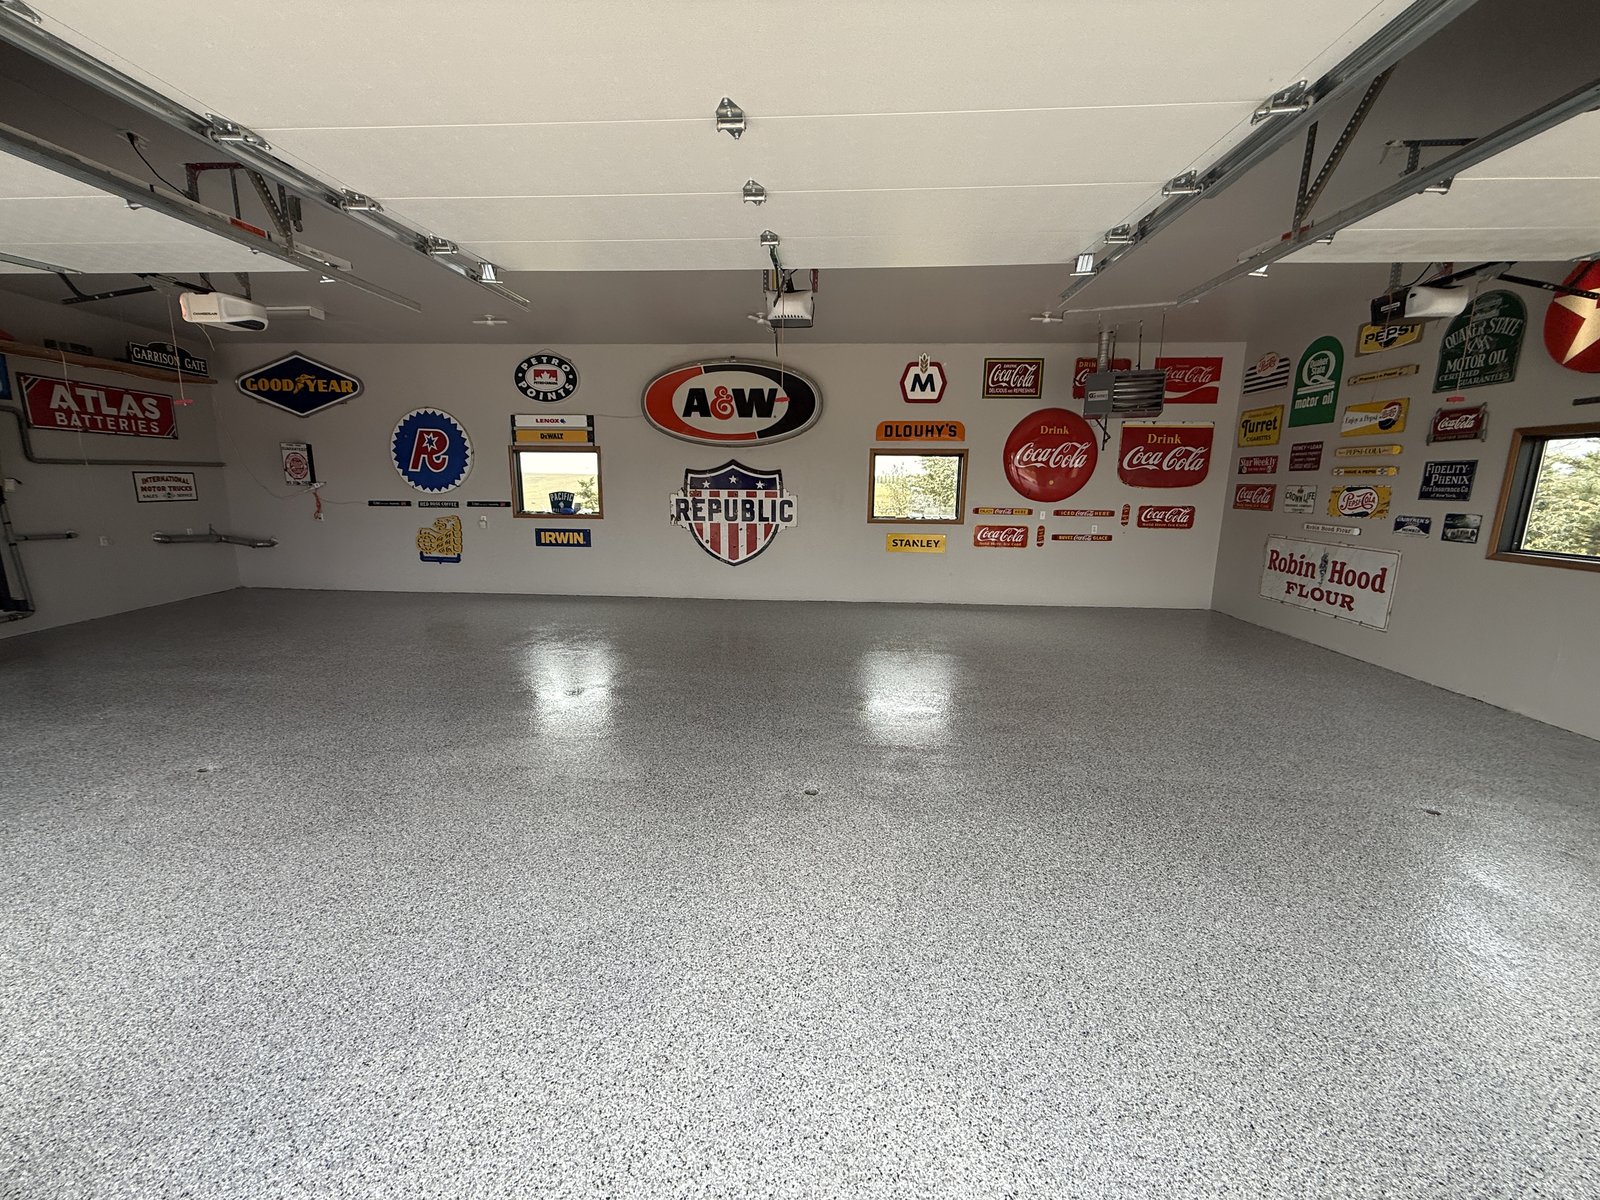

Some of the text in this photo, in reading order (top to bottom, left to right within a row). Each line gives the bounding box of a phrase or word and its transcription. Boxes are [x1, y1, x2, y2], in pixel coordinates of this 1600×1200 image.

[1445, 317, 1523, 349] QUAKER STATE
[133, 348, 206, 372] GARRISON GATE
[520, 356, 570, 372] PETRO
[1446, 349, 1508, 374] MOTOR OIL
[910, 374, 936, 392] M
[988, 364, 1038, 387] Coca-Cola
[1166, 366, 1215, 383] oca-Cola
[518, 380, 574, 400] POINTS
[50, 384, 161, 420] ATLAS
[682, 386, 778, 420] A&W
[1295, 390, 1334, 409] motor oil
[55, 412, 160, 433] BATTERIES
[884, 423, 957, 437] DLOUHY'S
[1040, 426, 1069, 434] Drink
[1242, 416, 1278, 438] Turret
[1147, 434, 1182, 444] Drink
[1014, 442, 1092, 468] Coca-Cola
[1240, 457, 1276, 467] Star Weekly
[141, 476, 190, 485] INTERNATIONAL
[1430, 474, 1470, 486] PHENIX
[550, 492, 573, 502] PACIFIC
[1303, 492, 1316, 502] LIFE
[676, 498, 793, 523] REPUBLIC
[1141, 507, 1192, 522] Coca-Cola
[540, 531, 584, 545] IRWIN
[892, 539, 940, 548] STANLEY
[977, 527, 1027, 542] Coca-Cola
[1268, 550, 1388, 593] Robin Hood
[1285, 581, 1355, 612] FLOUR
